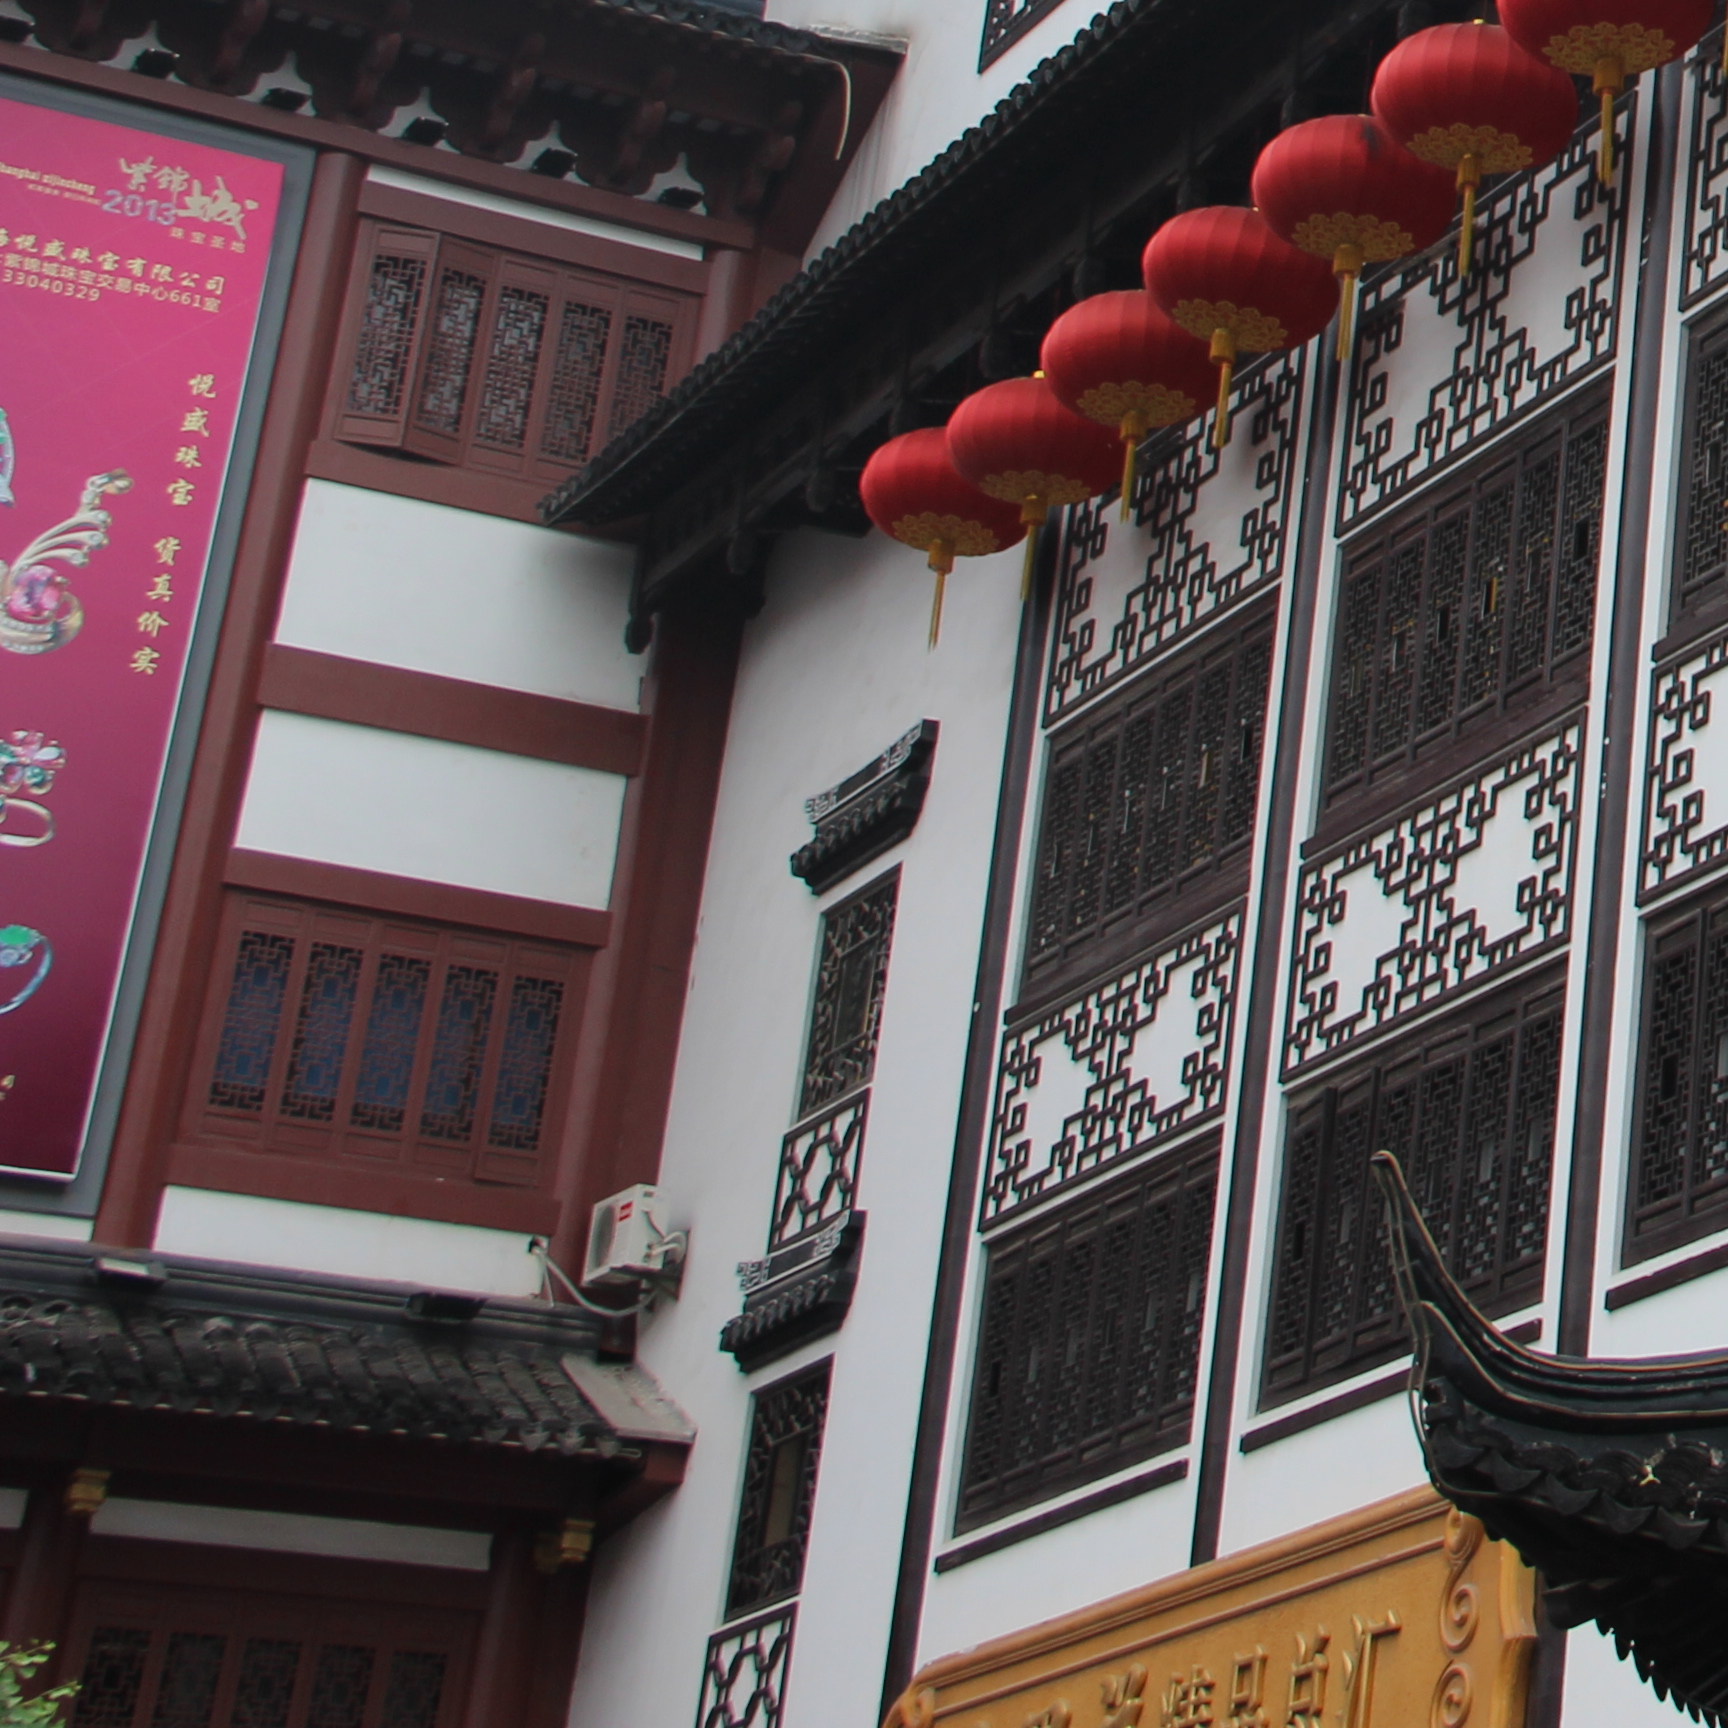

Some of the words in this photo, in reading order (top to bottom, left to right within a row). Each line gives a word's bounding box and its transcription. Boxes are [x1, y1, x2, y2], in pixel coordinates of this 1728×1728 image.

[102, 189, 176, 225] 2013
[166, 373, 217, 506] 悦盛珠宝
[129, 536, 181, 675] 货真价实
